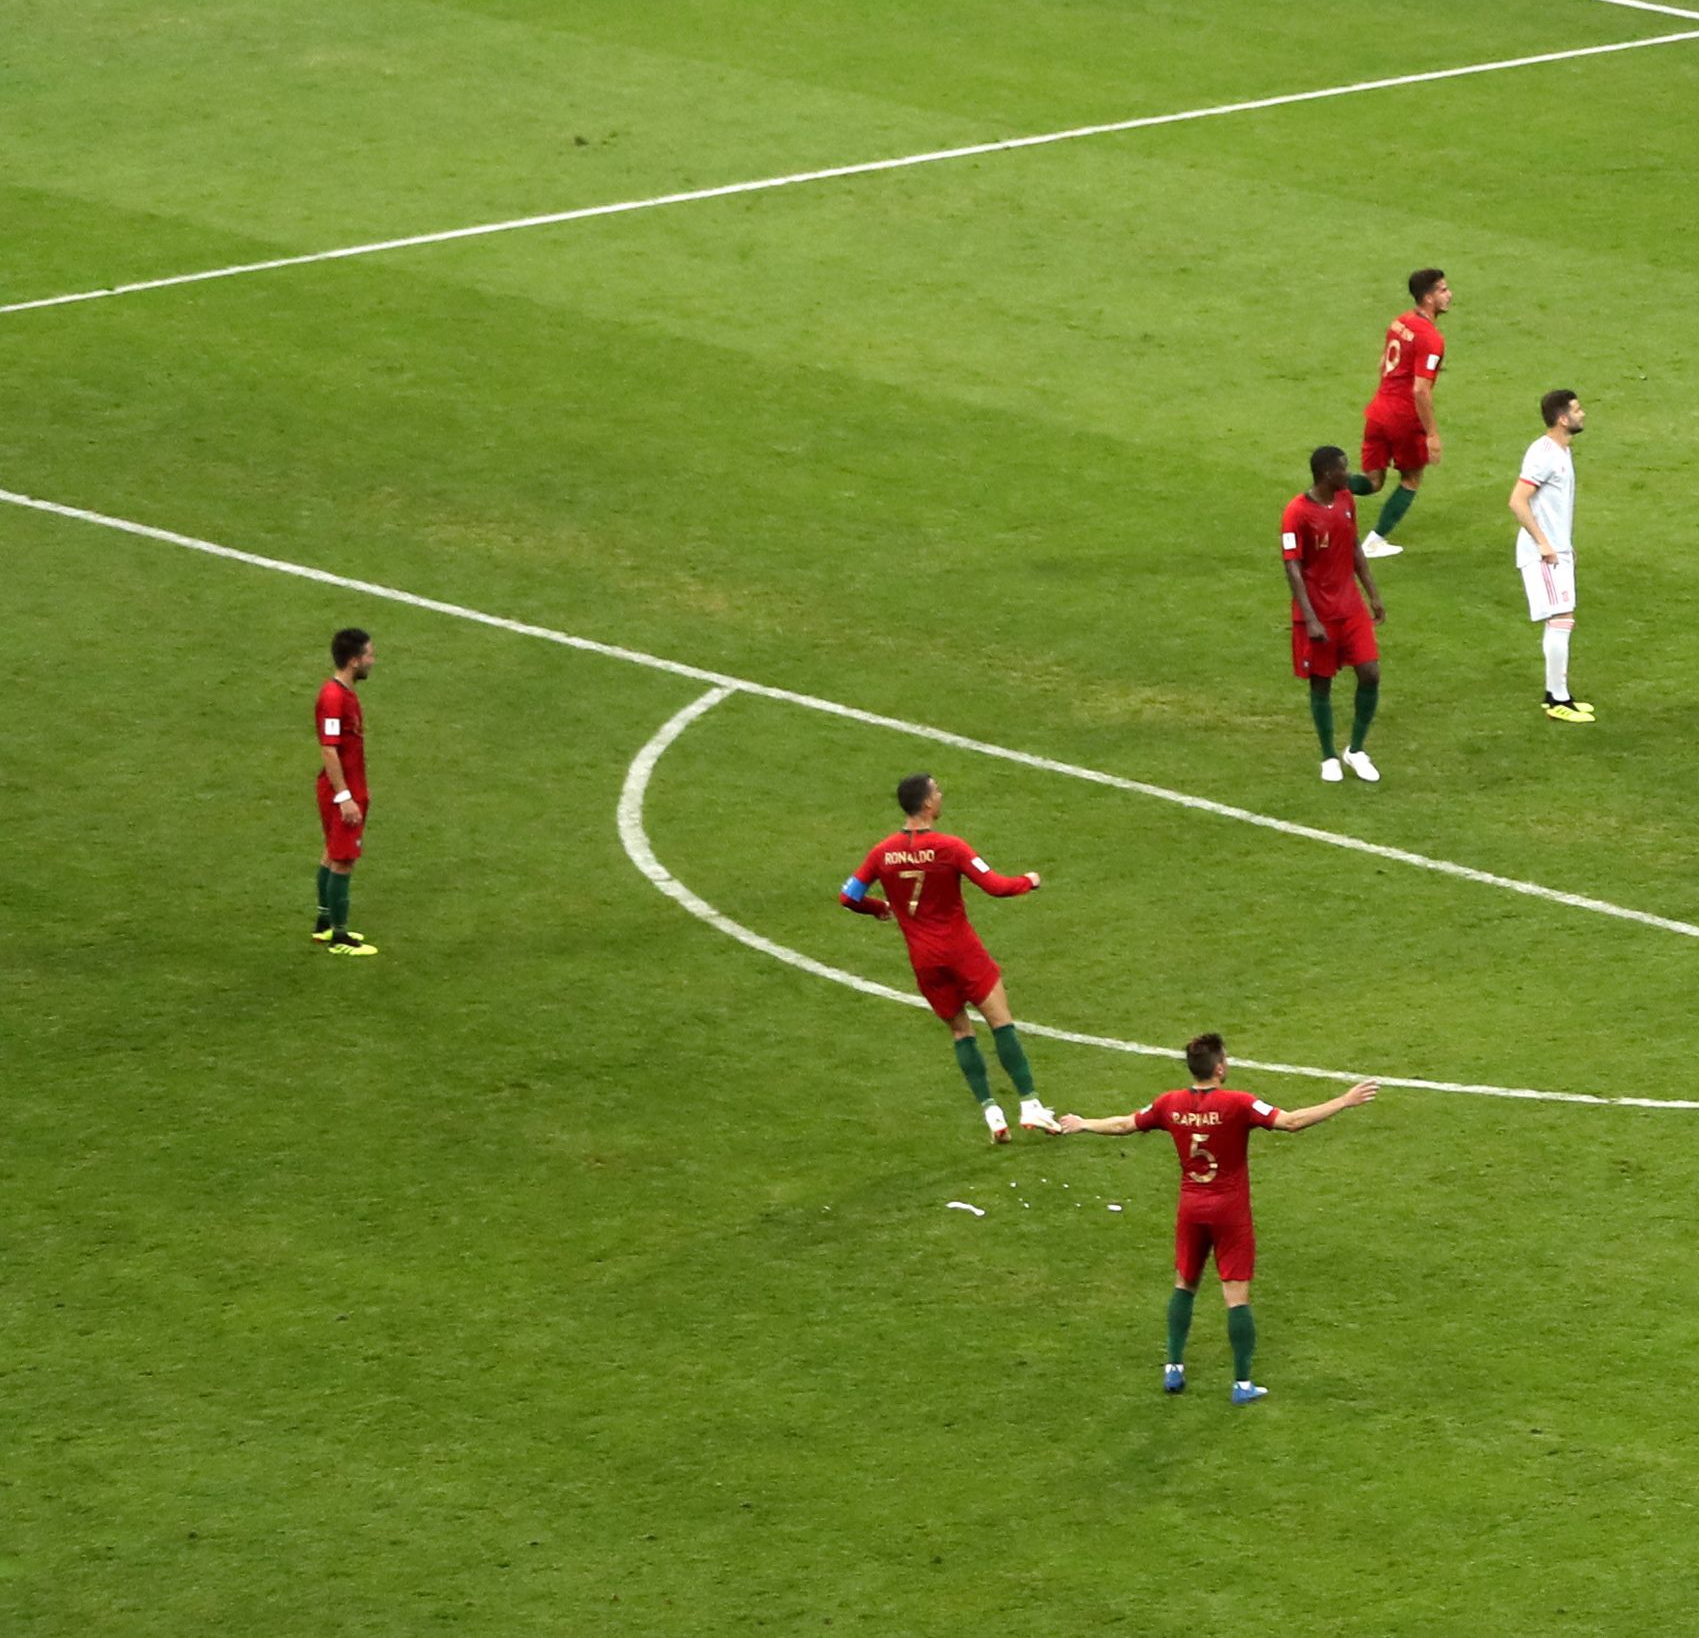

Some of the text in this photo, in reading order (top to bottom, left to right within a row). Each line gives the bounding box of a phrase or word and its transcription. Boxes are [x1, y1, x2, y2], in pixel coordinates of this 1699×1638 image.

[885, 849, 935, 866] RONALDO
[898, 870, 926, 917] 7
[1172, 1111, 1223, 1126] RAPHAEL
[1190, 1133, 1219, 1184] 5
